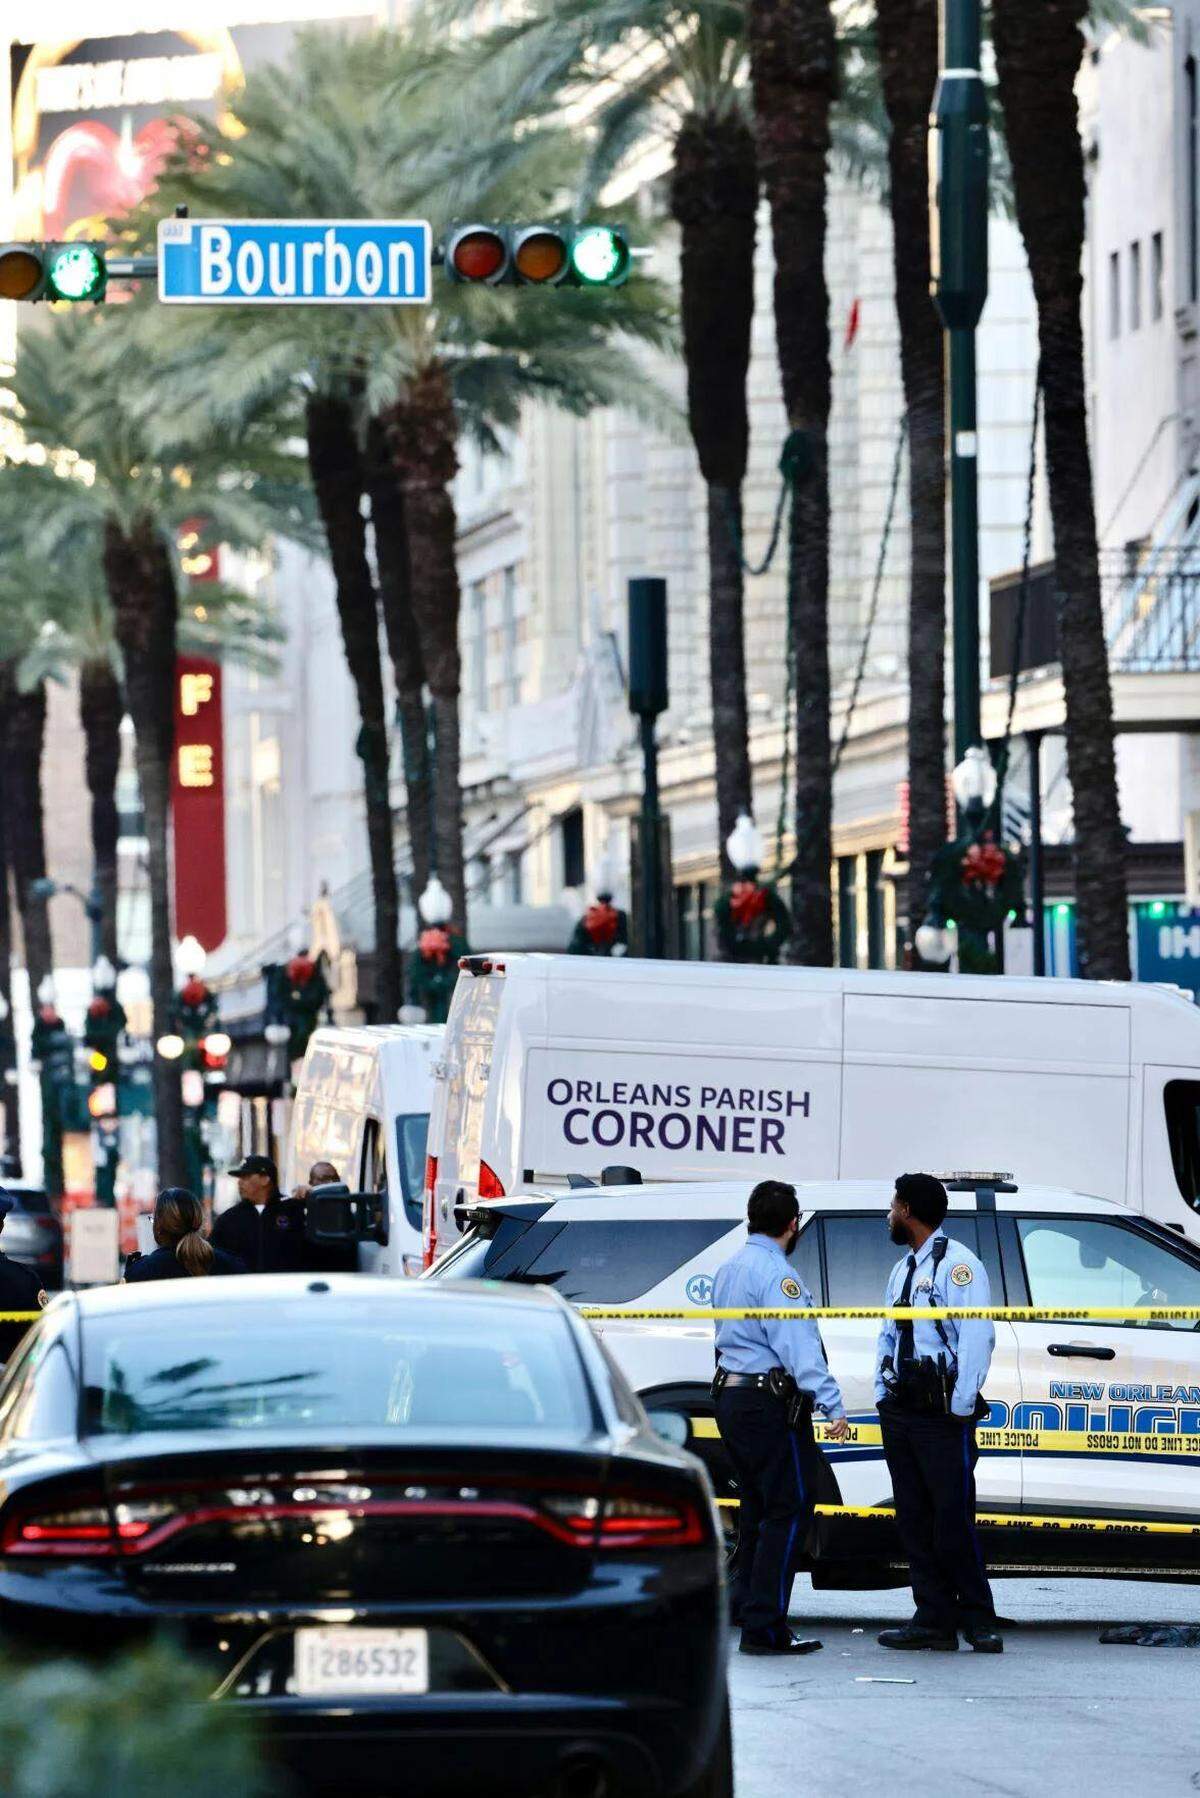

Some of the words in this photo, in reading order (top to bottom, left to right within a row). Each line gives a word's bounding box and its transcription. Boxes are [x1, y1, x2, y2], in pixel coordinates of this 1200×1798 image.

[200, 227, 415, 297] Bourbon
[547, 1078, 691, 1107] ORLEANS
[700, 1086, 810, 1118] PARISH
[563, 1107, 786, 1155] CORONER
[1050, 1381, 1106, 1399] NEW
[980, 1431, 1001, 1446] LINE
[1004, 1432, 1039, 1447] POLICE
[1087, 1434, 1119, 1449] CROSS
[1122, 1435, 1141, 1449] NOT
[1144, 1436, 1158, 1450] DO
[1161, 1437, 1183, 1451] LINE
[321, 1648, 416, 1677] 286532
